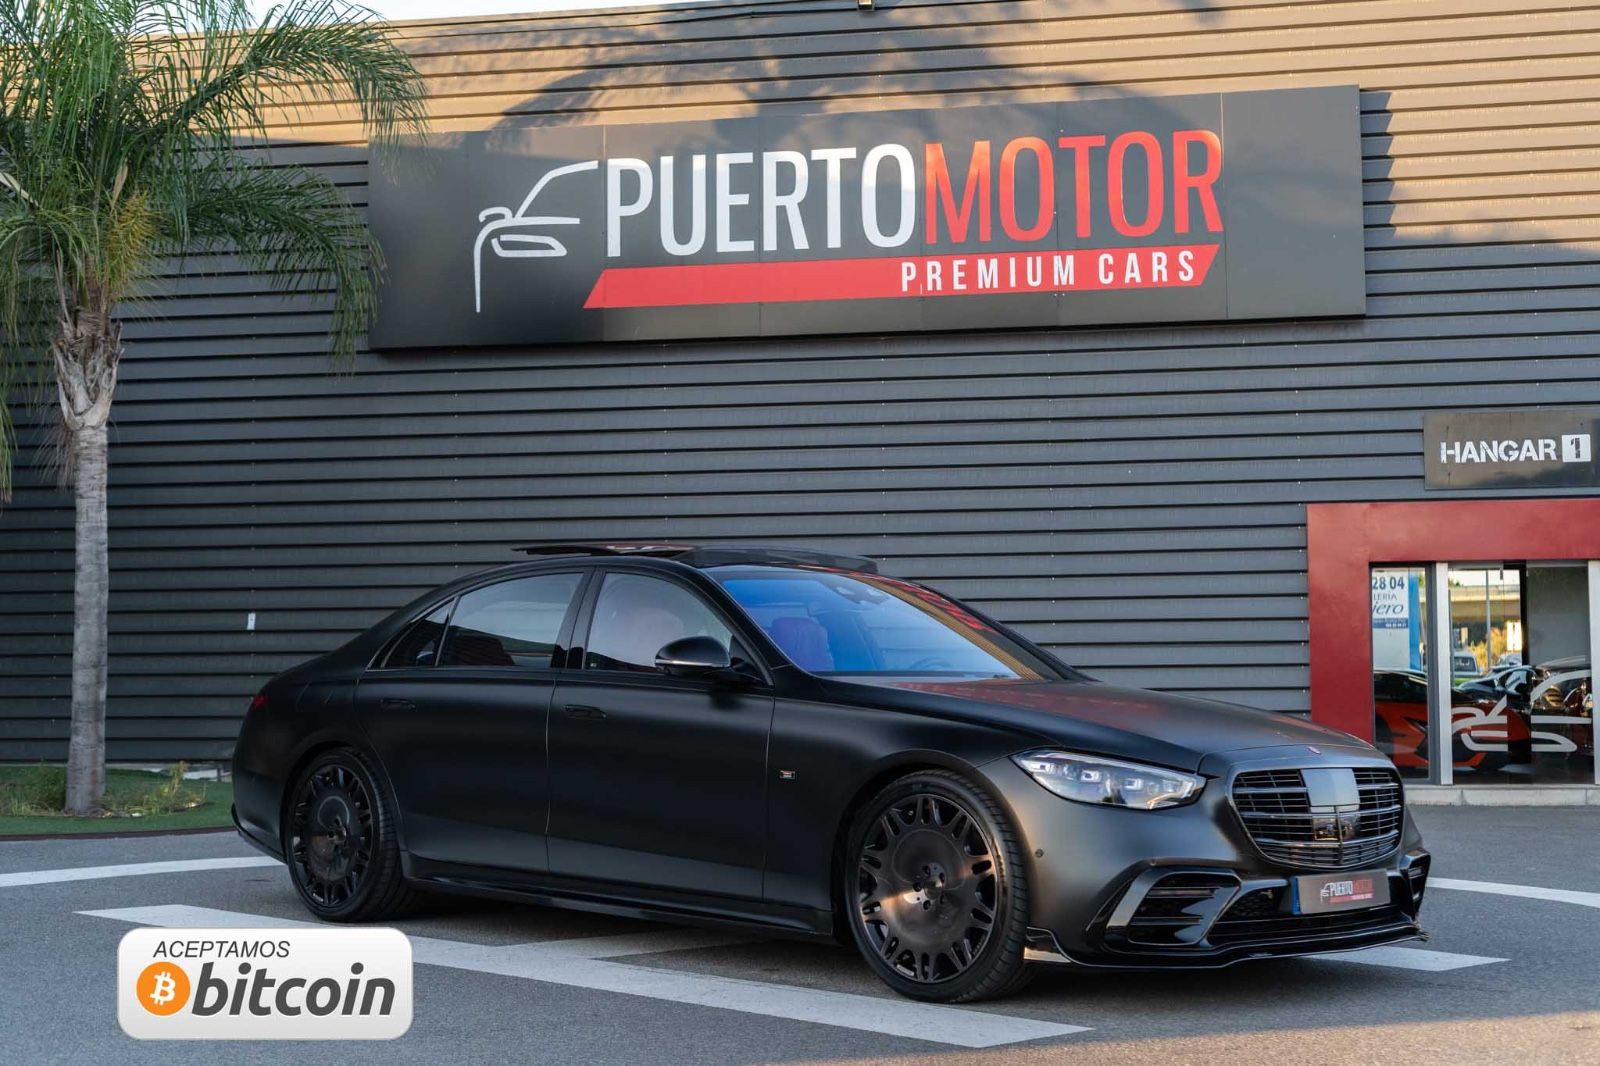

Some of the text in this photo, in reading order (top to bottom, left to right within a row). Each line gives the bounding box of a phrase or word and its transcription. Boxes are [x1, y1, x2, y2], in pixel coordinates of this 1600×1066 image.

[901, 249, 1195, 293] PREMIUM CARS
[1440, 438, 1557, 464] HANGAR
[1389, 577, 1405, 590] 04
